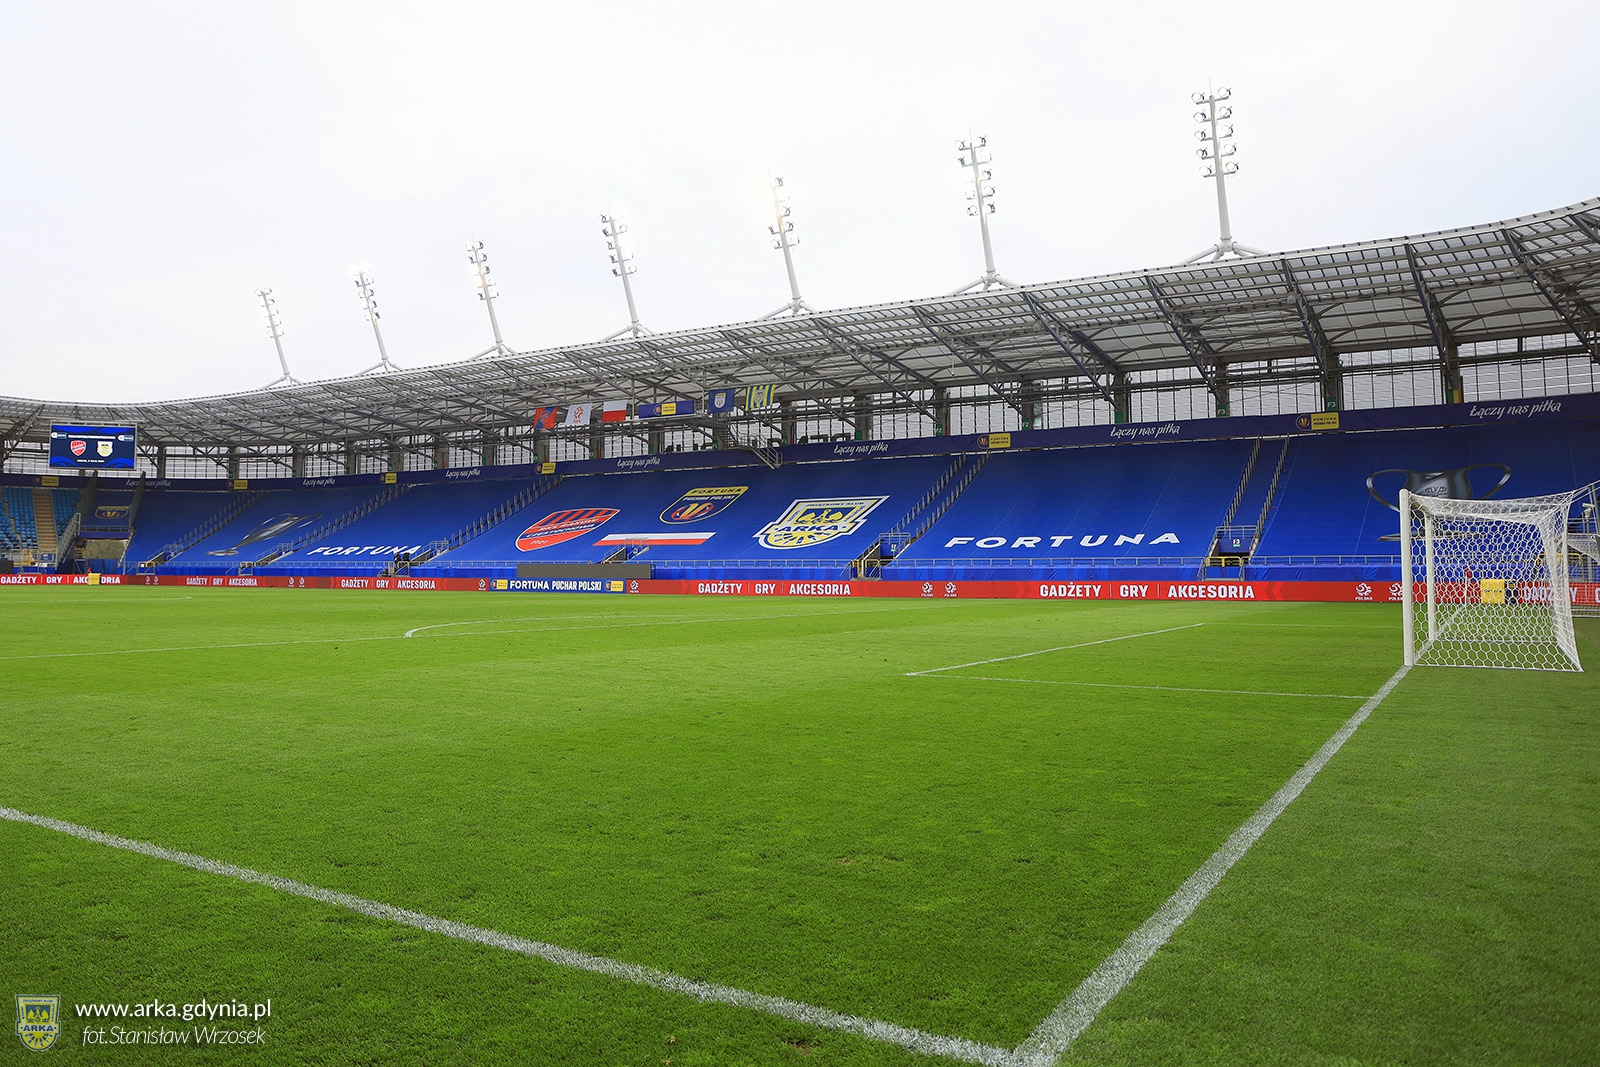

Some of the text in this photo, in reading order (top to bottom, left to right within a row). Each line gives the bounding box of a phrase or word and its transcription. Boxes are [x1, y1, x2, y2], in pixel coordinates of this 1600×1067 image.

[1470, 400, 1562, 420] Łączy nas piłka
[1110, 423, 1181, 439] Łączy nas piłka
[834, 444, 856, 456] Łączy
[868, 442, 888, 455] piłka
[617, 458, 635, 468] Łączy
[644, 456, 661, 468] piłka
[944, 532, 1181, 548] FORTUNA
[307, 546, 421, 556] FORTUNA
[0, 575, 37, 584] GADŻETY
[186, 576, 208, 585] GADŻETY
[229, 578, 258, 586] AKCESORIA
[341, 577, 435, 589] GADŻETY GRY AKCESORIA
[510, 581, 549, 590] FORTUNA
[552, 581, 577, 591] PUCHAR
[578, 581, 601, 591] POLSKI
[698, 580, 850, 595] GADŻETY GRY AKCESORIA
[1040, 582, 1255, 599] GADŻETY GRY AKCESORIA
